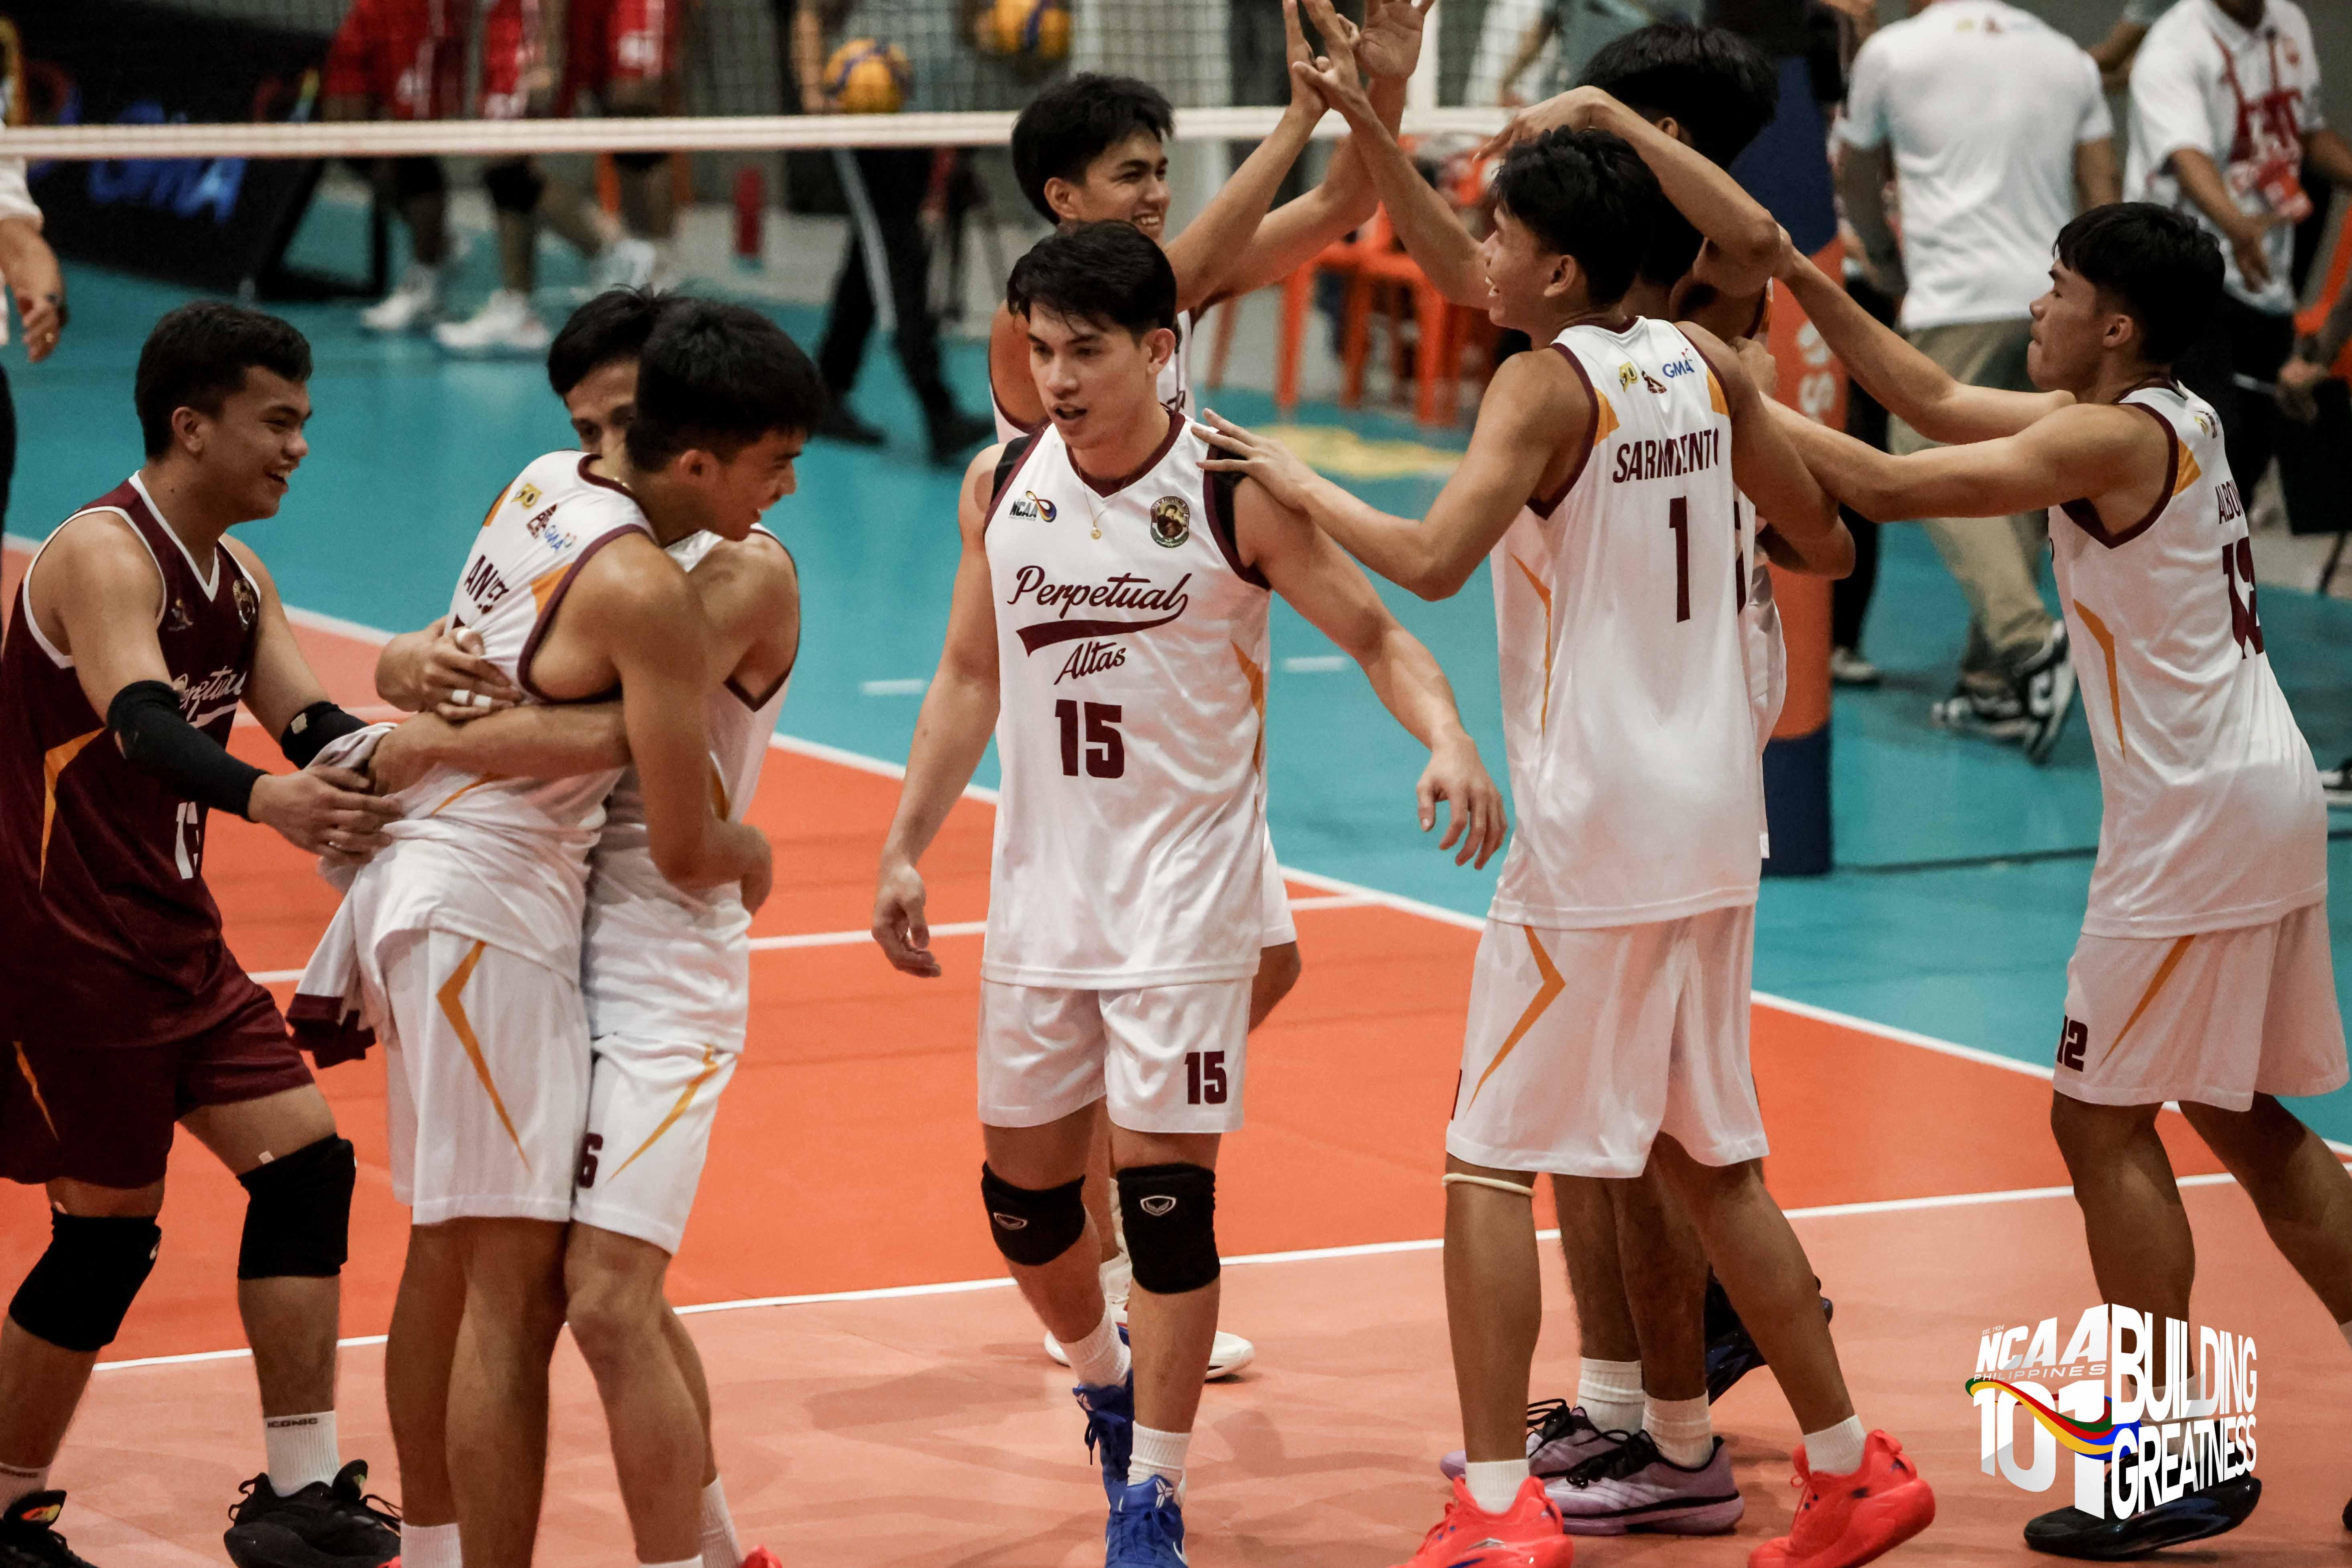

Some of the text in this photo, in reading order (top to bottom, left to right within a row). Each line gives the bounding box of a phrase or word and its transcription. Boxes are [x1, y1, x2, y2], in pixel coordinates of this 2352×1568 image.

[1662, 360, 1695, 378] GMA
[1009, 500, 1038, 518] NCAA
[1669, 496, 1690, 623] 1
[1007, 565, 1192, 619] Perpetual
[1053, 641, 1126, 685] Altas
[1055, 699, 1125, 779] 15
[1184, 1050, 1227, 1105] 15
[266, 1418, 319, 1428] ICONIC
